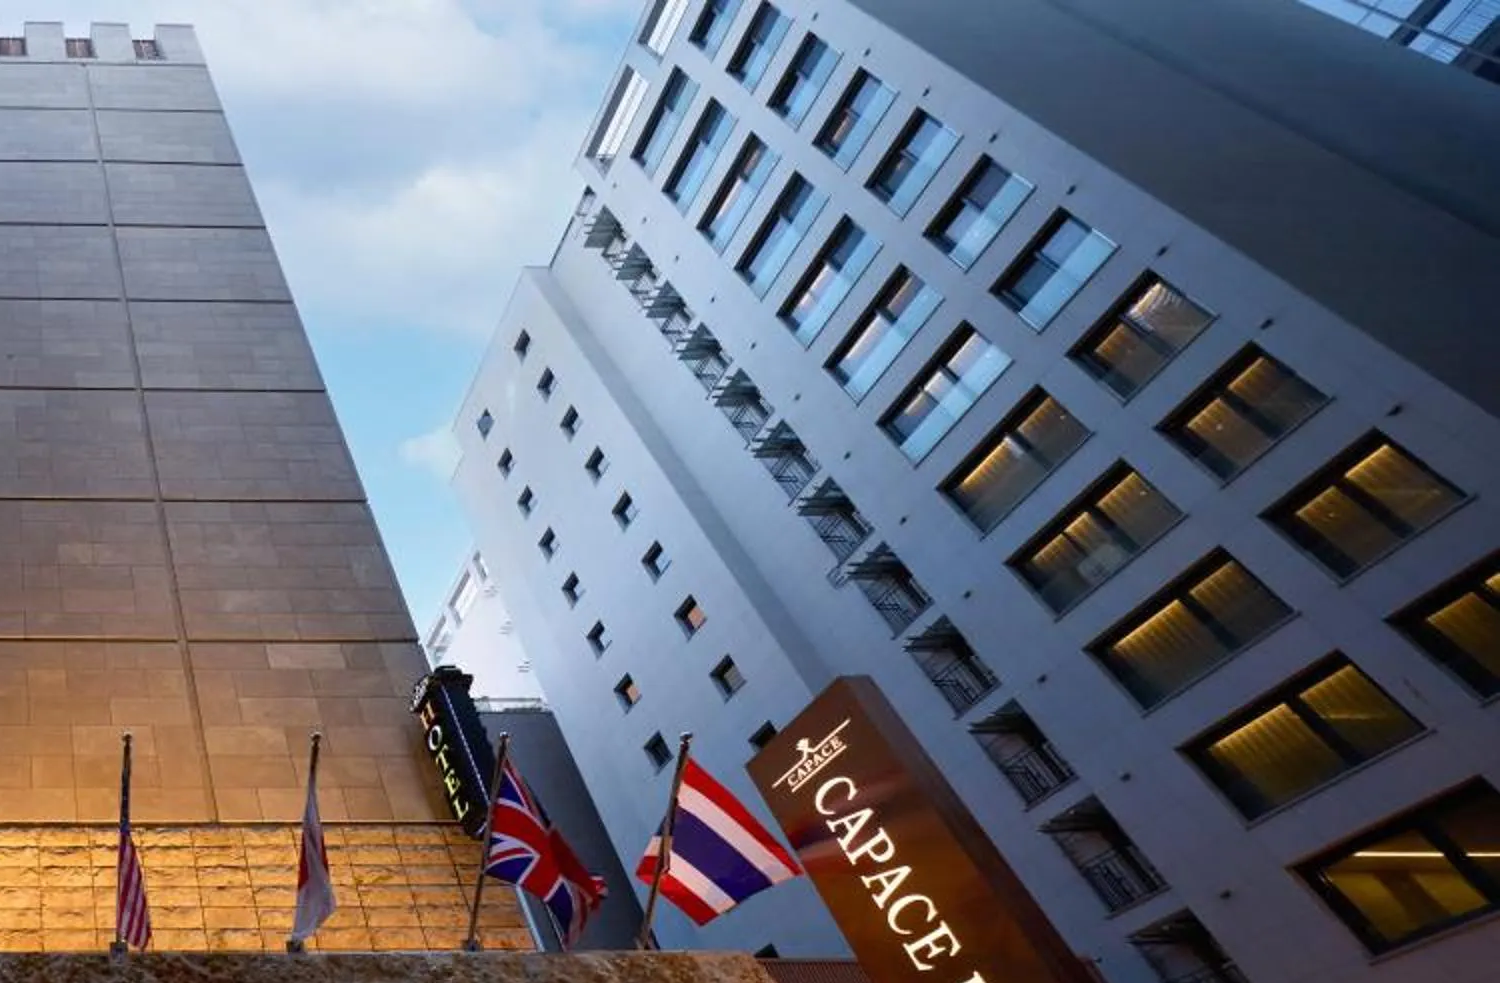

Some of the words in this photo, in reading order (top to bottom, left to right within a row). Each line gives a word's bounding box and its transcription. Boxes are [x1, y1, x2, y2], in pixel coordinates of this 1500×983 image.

[420, 701, 469, 820] HOTEL
[787, 735, 843, 787] CAPACE
[814, 776, 961, 971] CAPACE
